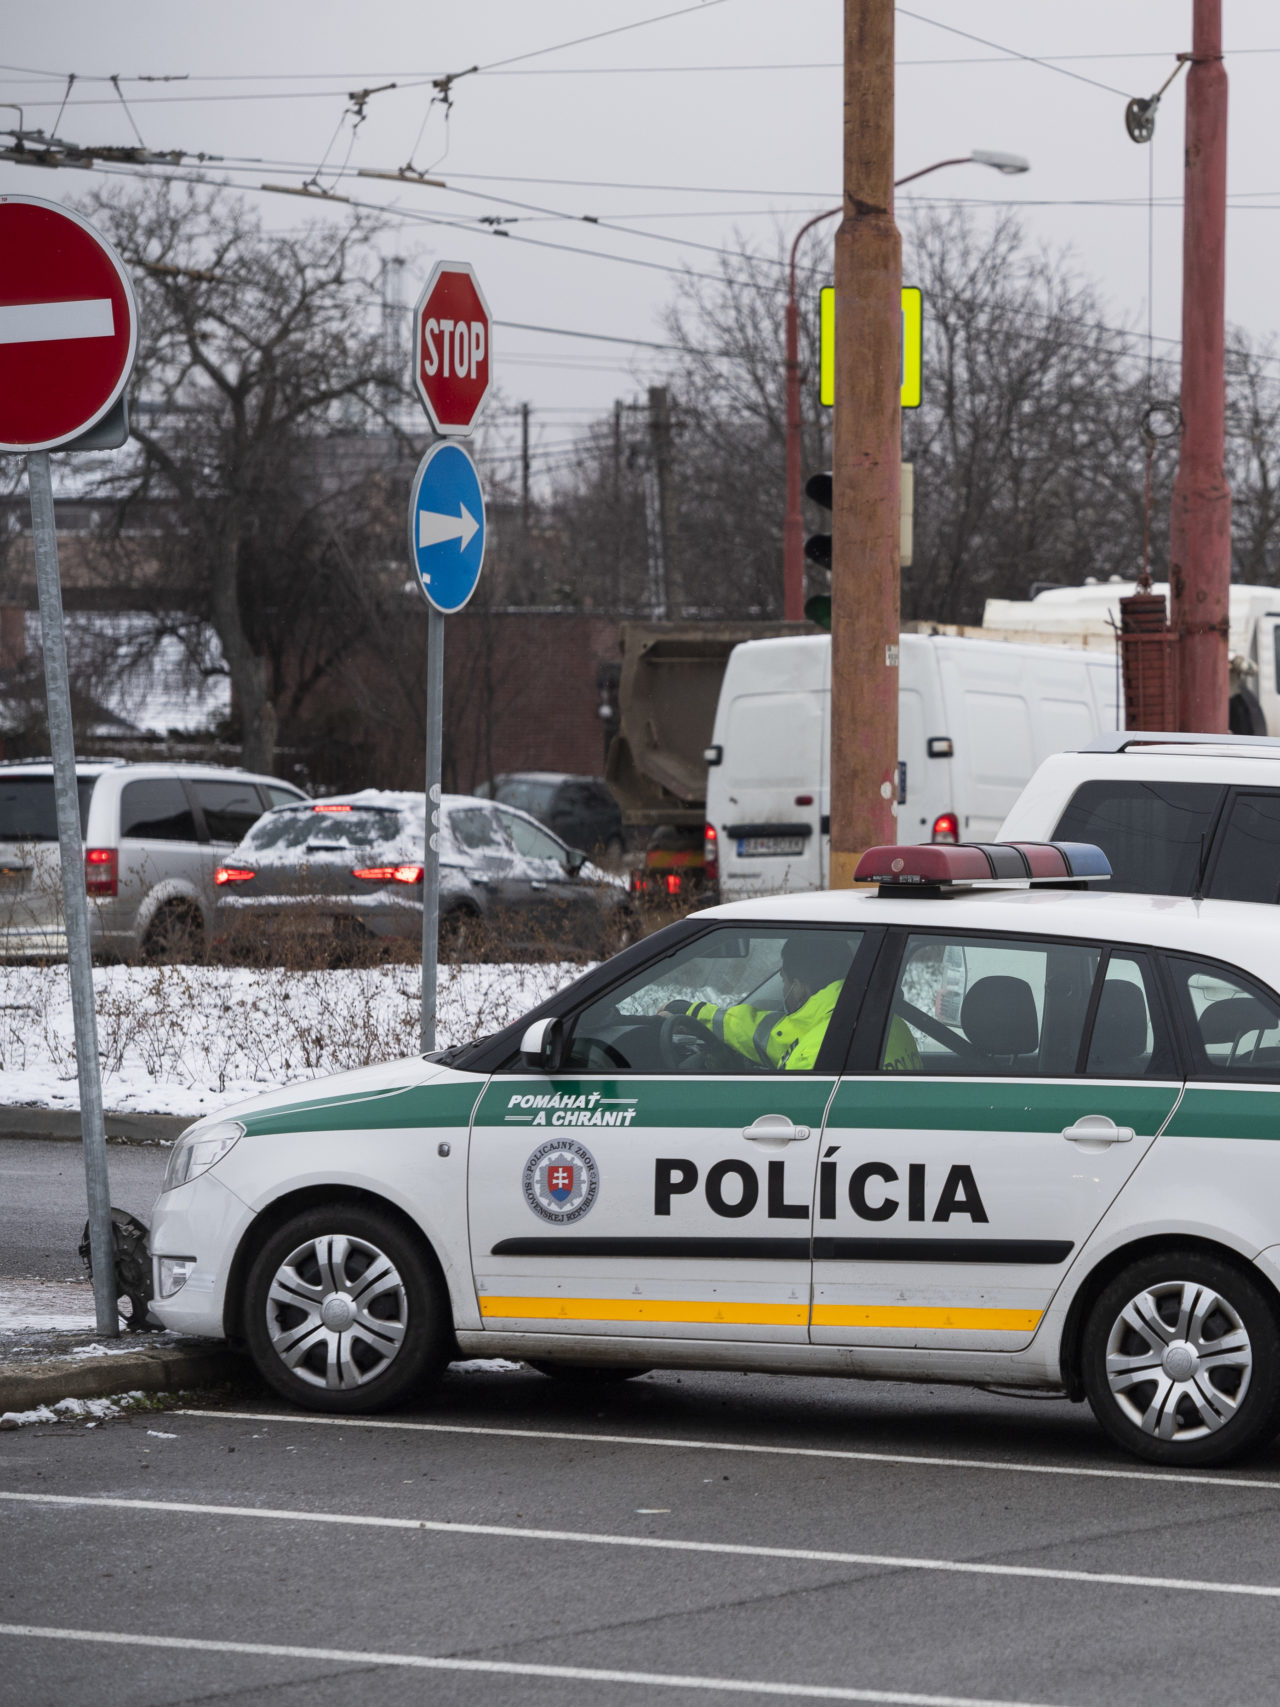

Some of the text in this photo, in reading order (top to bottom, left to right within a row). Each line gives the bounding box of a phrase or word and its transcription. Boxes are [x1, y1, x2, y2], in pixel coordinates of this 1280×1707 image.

[424, 317, 485, 379] STOP
[508, 1092, 602, 1108] POMÁHAŤ
[532, 1108, 636, 1126] A CHRÁNIŤ
[526, 1140, 595, 1173] POLICAJNÝ ZBOR
[525, 1179, 597, 1222] SLOVENSKEJ REPUBLIKY
[654, 1146, 990, 1223] POLÍCIA
